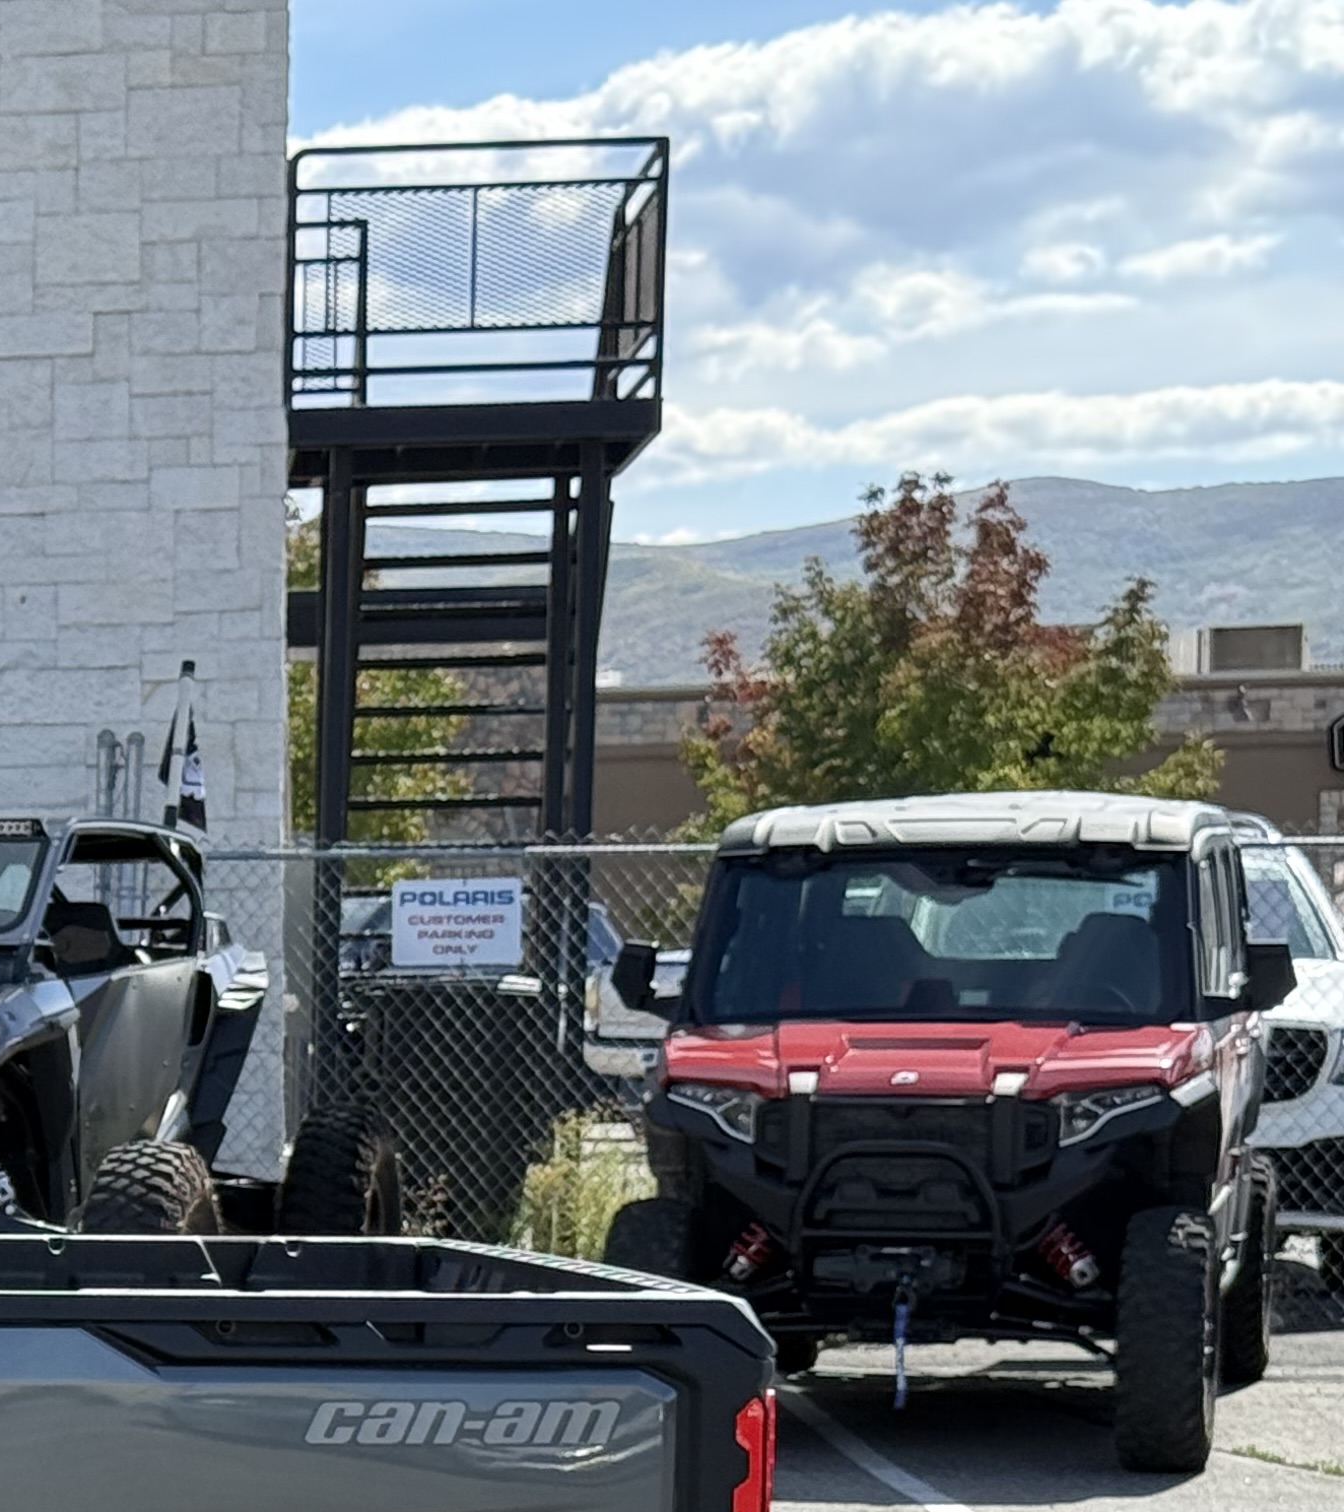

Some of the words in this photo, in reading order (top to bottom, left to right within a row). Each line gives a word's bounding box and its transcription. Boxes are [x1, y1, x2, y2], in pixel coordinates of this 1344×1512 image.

[399, 889, 515, 907] POLARIS
[407, 914, 505, 926] CUSTOMER
[417, 929, 494, 940] PARKING
[432, 944, 478, 955] ONLY
[304, 1401, 621, 1445] can-am
